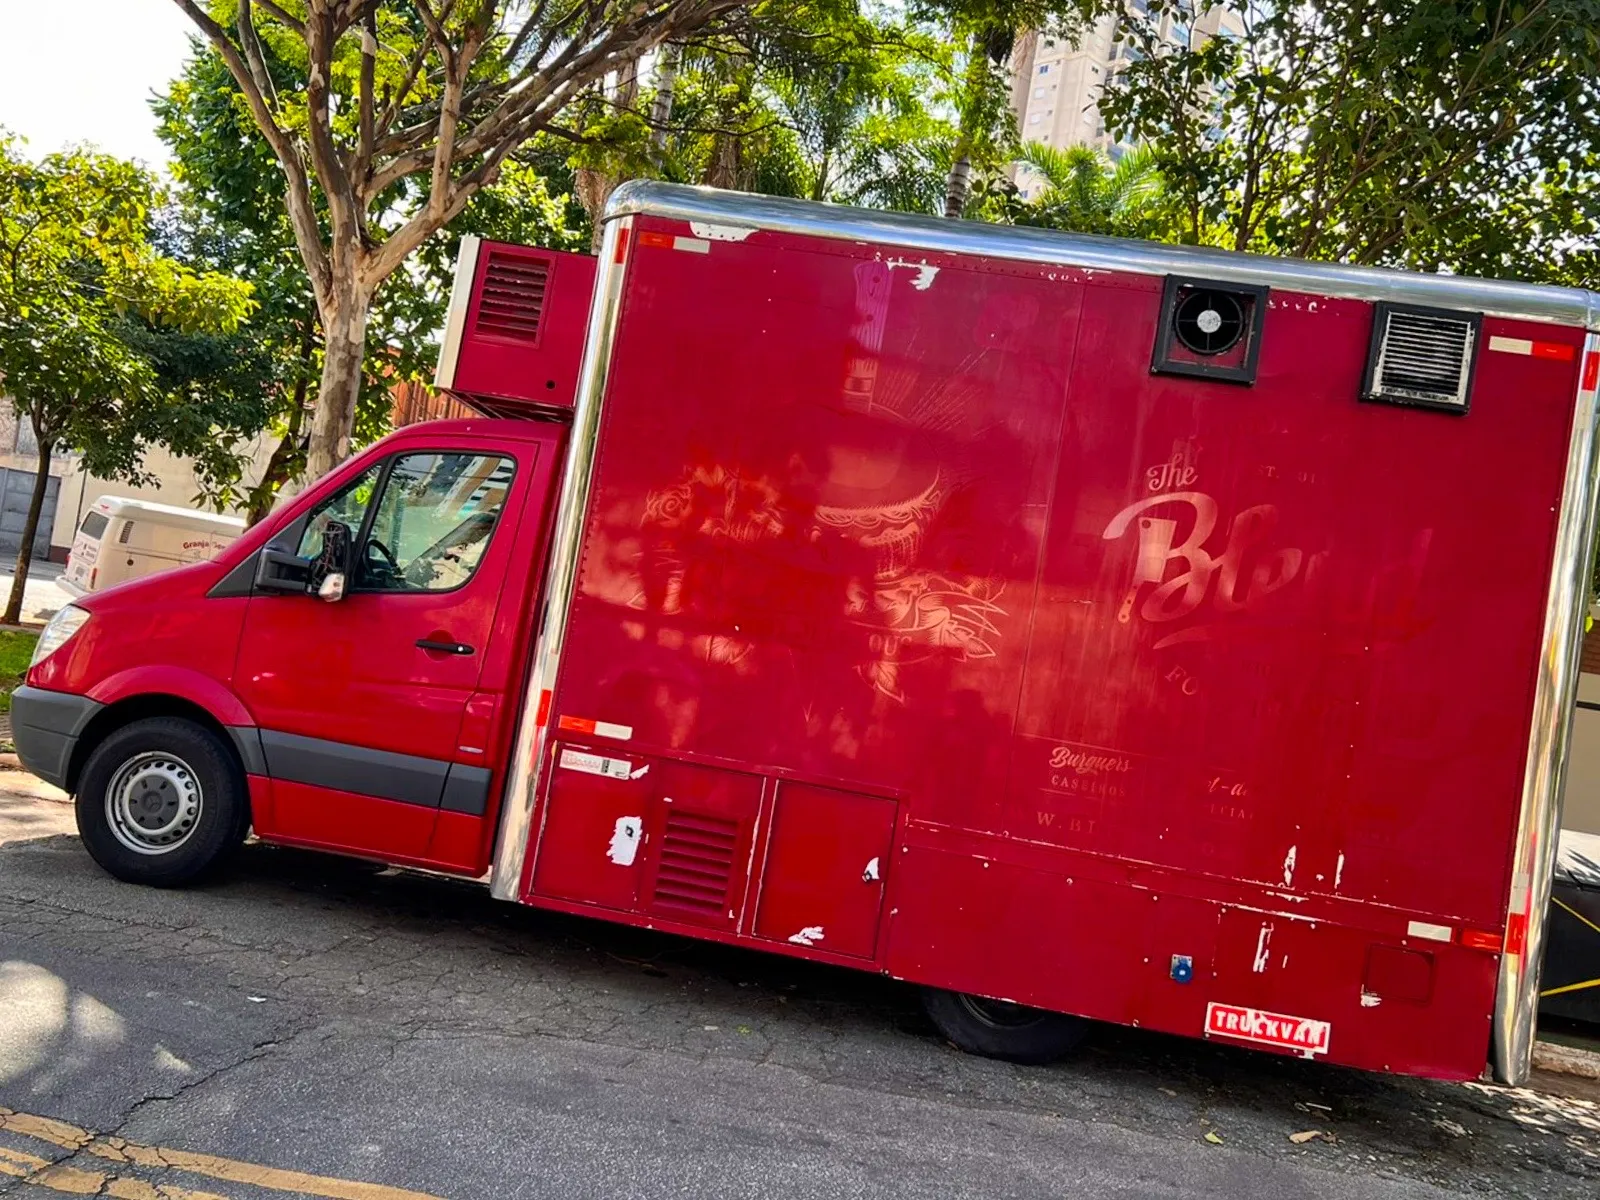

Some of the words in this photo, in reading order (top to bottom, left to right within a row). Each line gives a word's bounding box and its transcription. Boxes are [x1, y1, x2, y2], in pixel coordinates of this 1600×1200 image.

[1146, 452, 1198, 491] The
[182, 539, 210, 550] Granja
[1048, 746, 1132, 776] Burguers
[1214, 1010, 1323, 1045] TRUCKVAN
